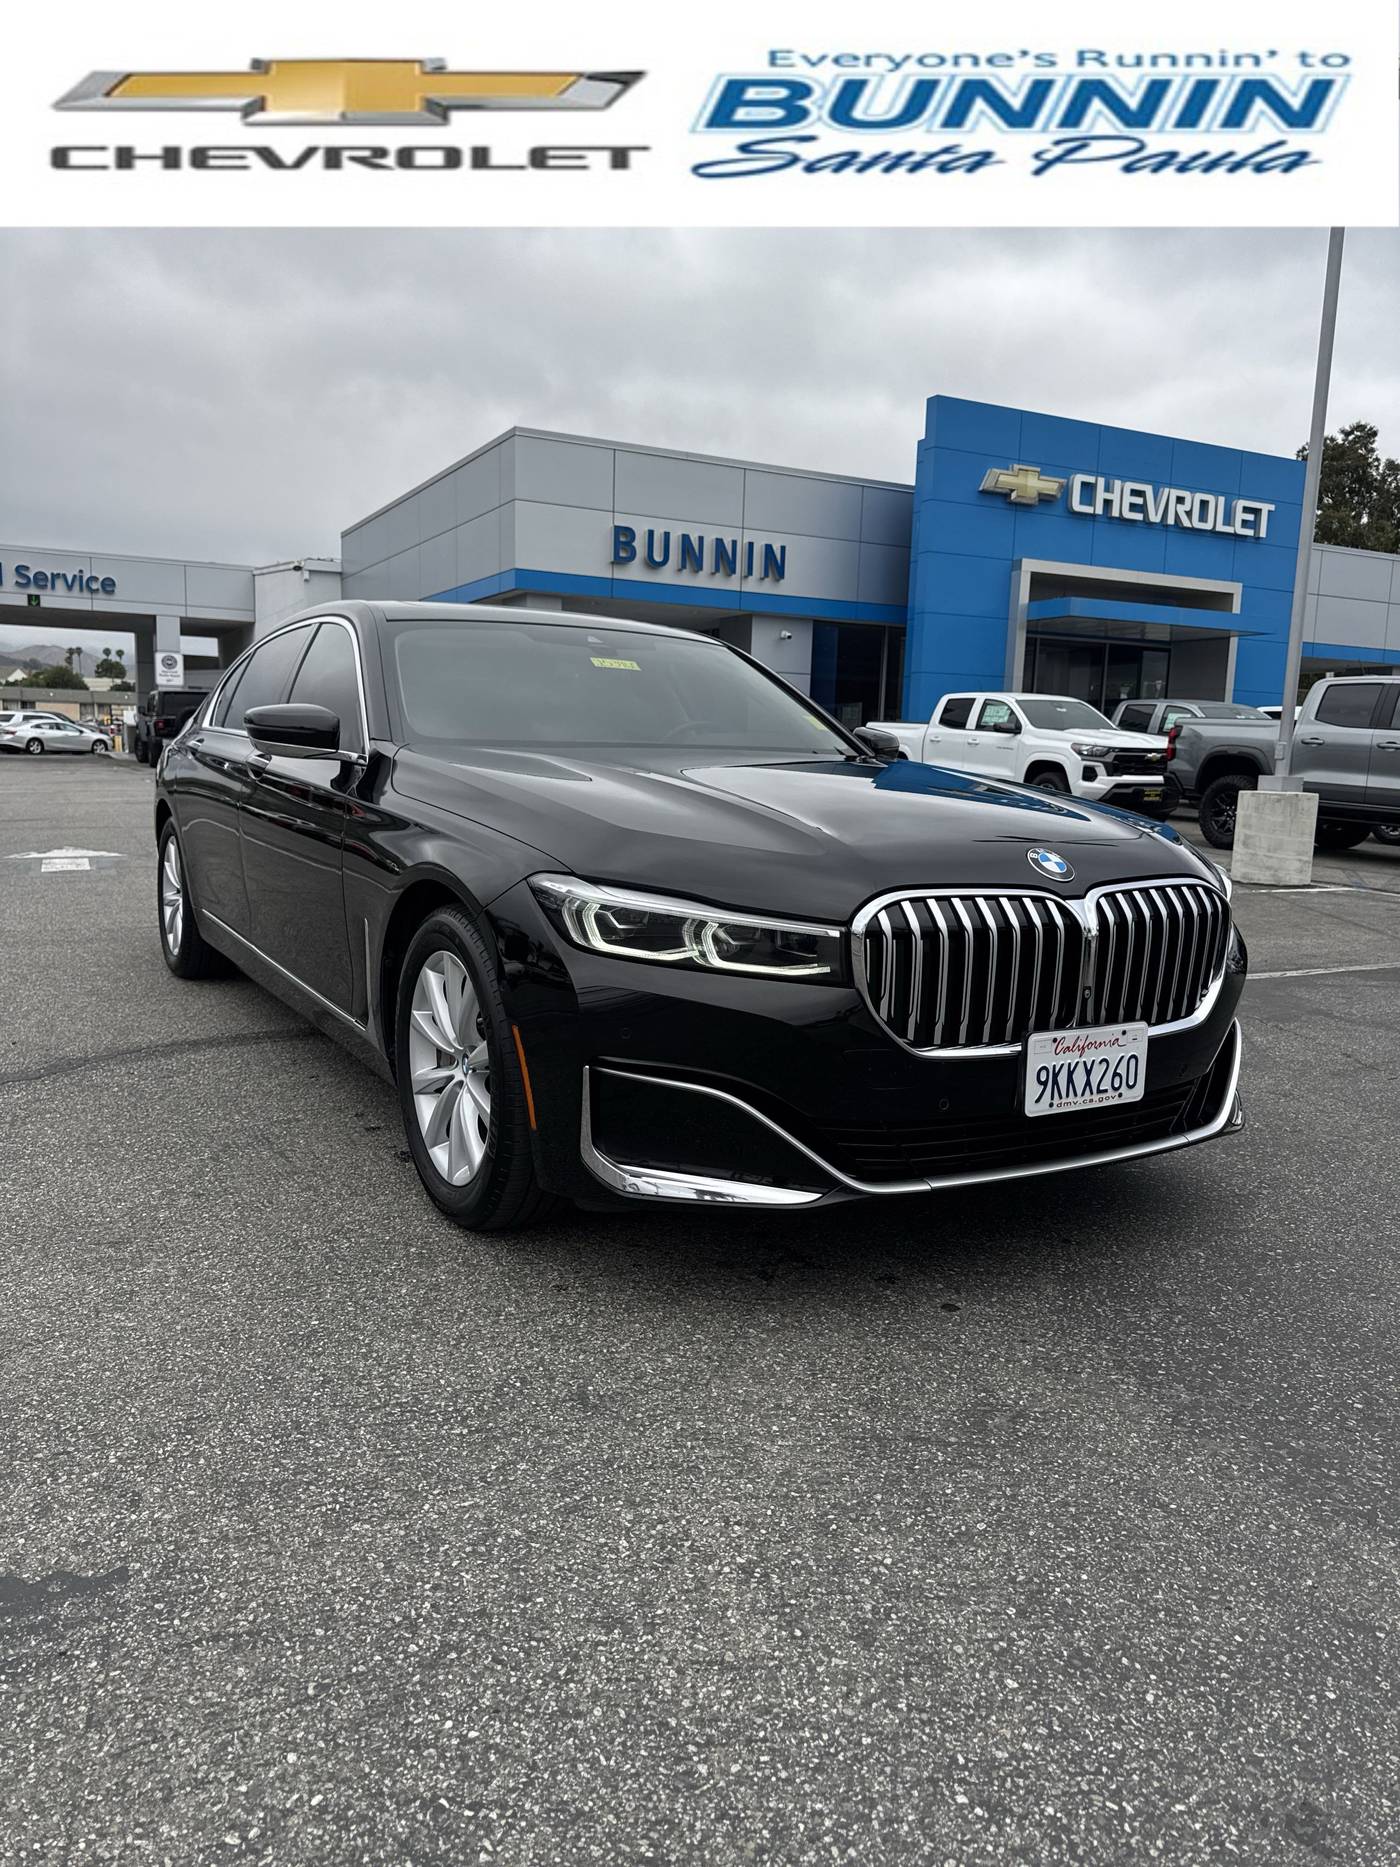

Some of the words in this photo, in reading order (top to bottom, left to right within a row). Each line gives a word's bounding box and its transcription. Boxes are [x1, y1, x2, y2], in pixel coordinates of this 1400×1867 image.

[1068, 473, 1276, 539] CHEVROLET
[612, 525, 788, 581] BUNNIN
[15, 564, 116, 594] Service
[1053, 1033, 1126, 1057] California
[1034, 1053, 1139, 1104] 9KKX260
[1056, 1094, 1117, 1108] dmv.ca.gov
